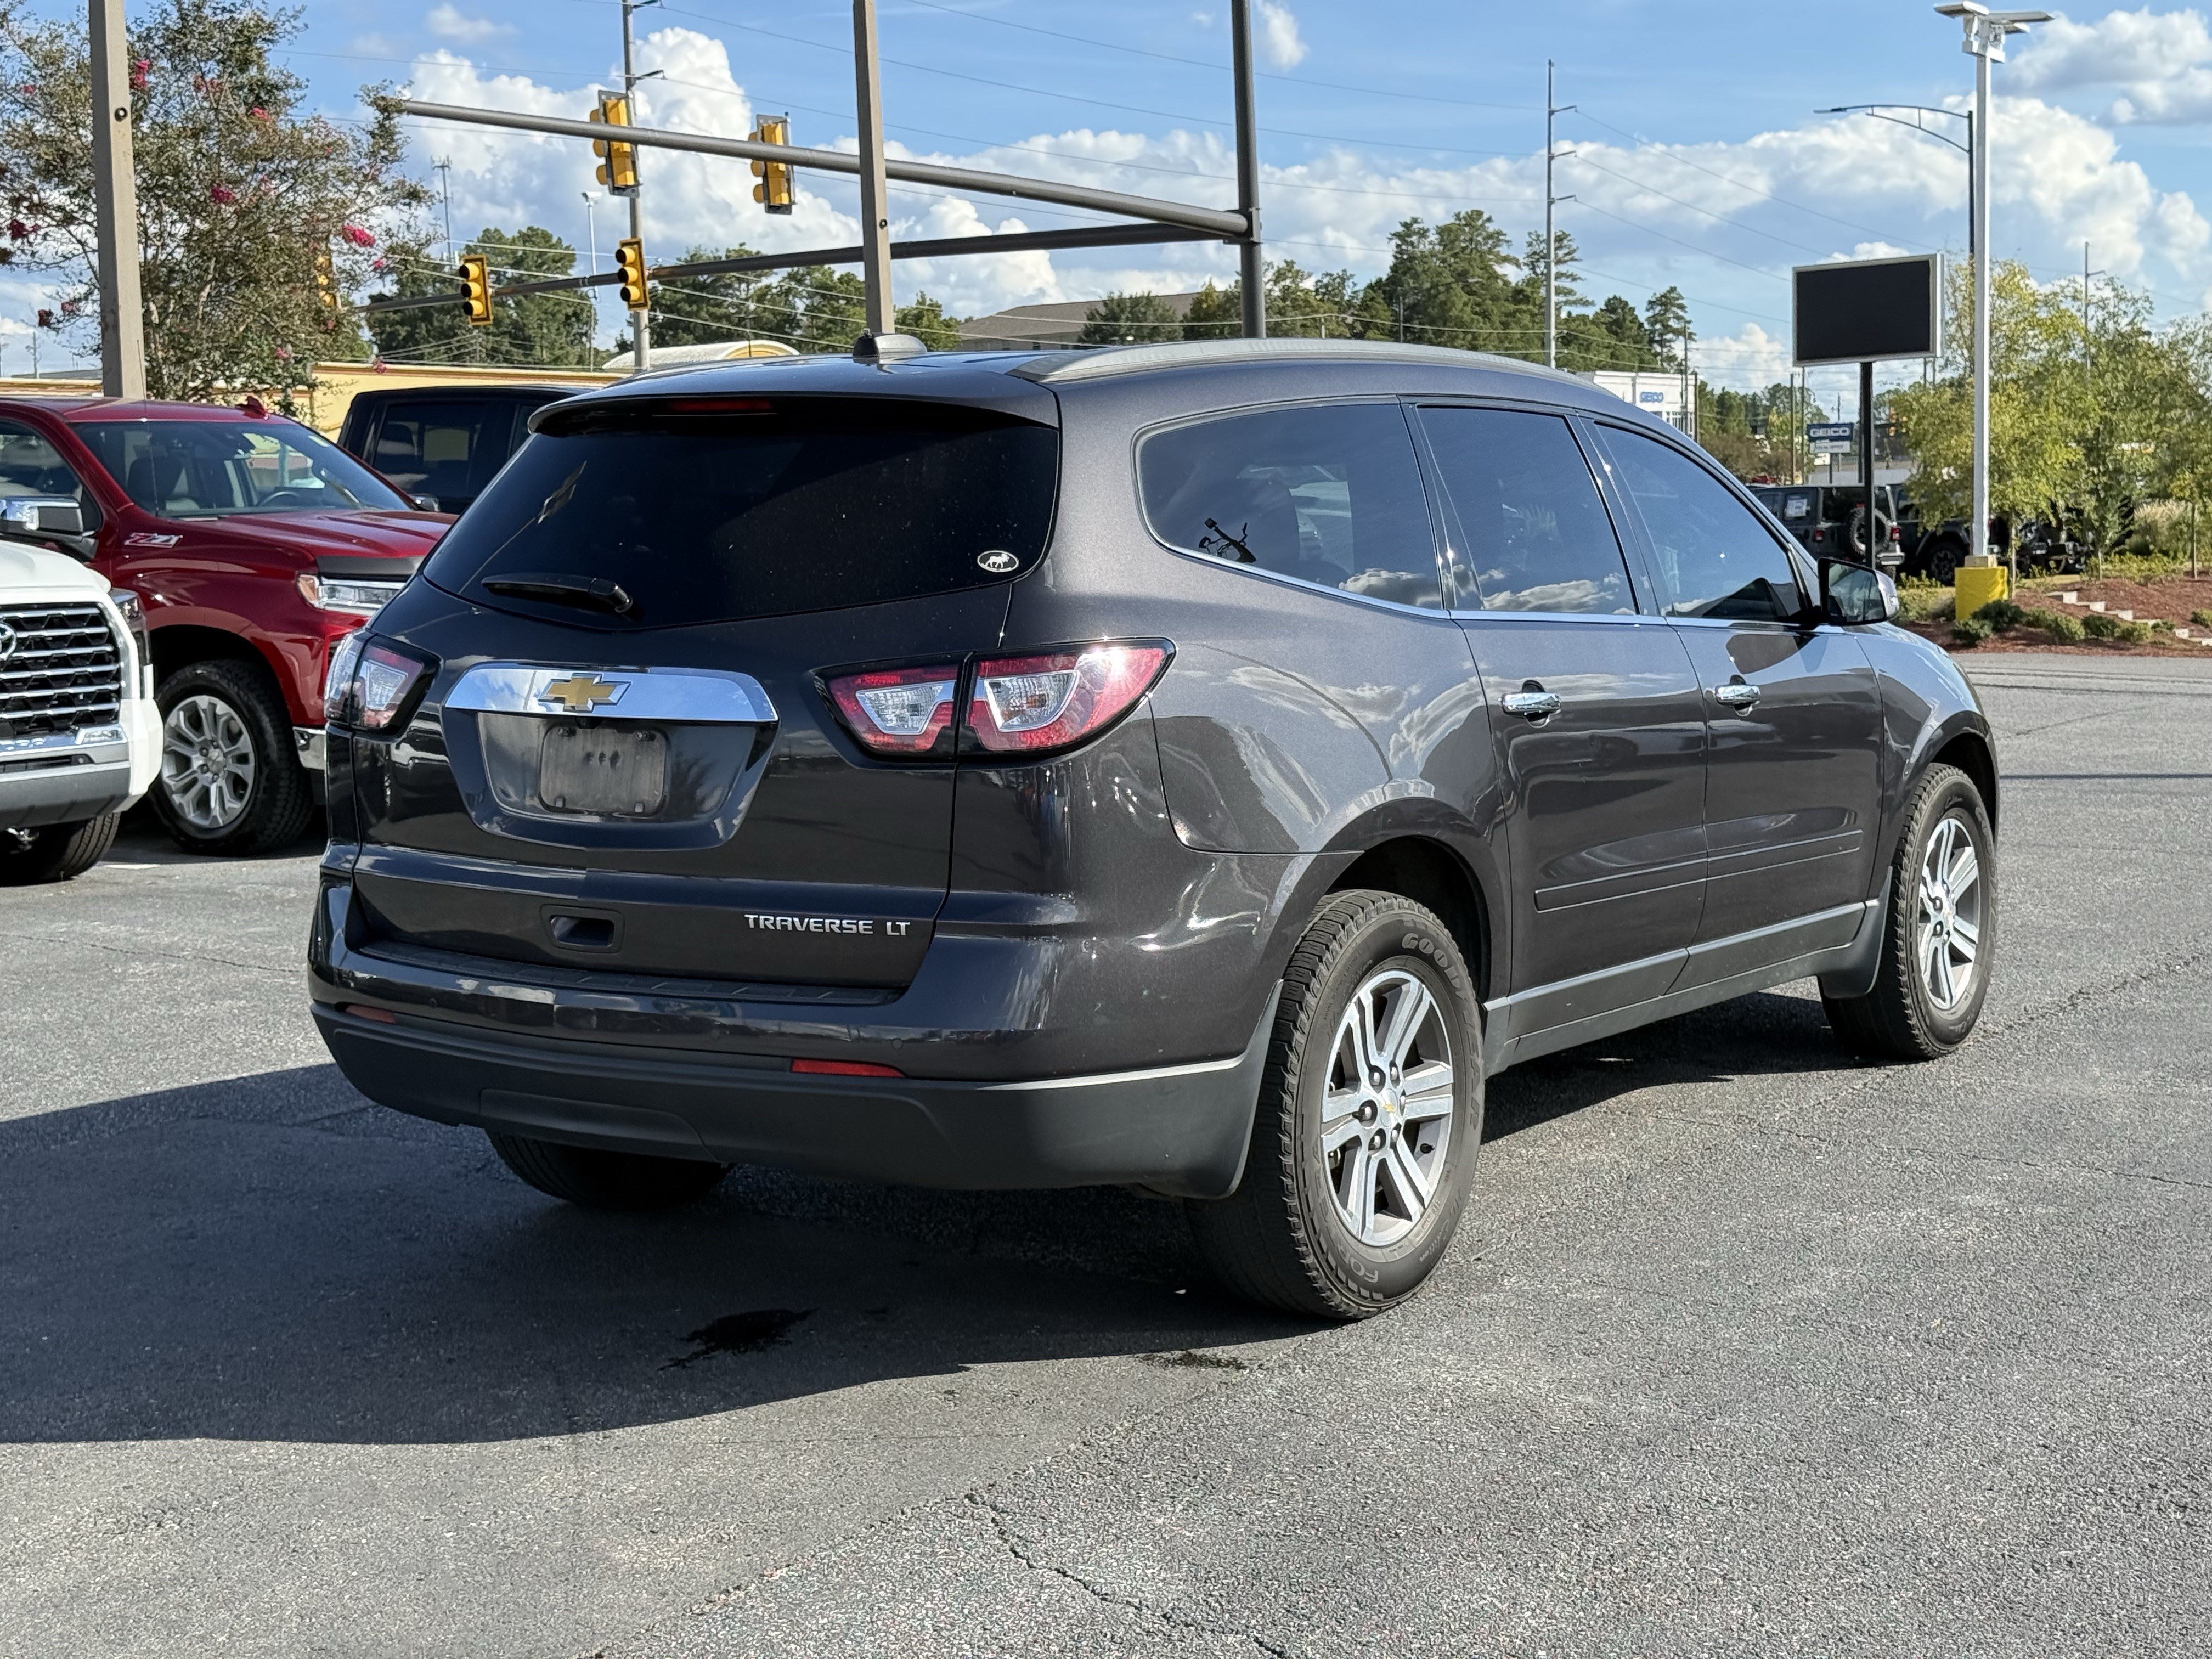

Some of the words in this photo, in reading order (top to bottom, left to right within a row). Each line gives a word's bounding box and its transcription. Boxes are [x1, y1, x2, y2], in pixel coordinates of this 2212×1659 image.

[1640, 392, 1663, 403] GEICO
[1810, 427, 1850, 437] GEICO
[744, 914, 873, 934] TRAVERSE
[886, 921, 911, 936] LT
[1402, 933, 1480, 1130] GOODYEAR
